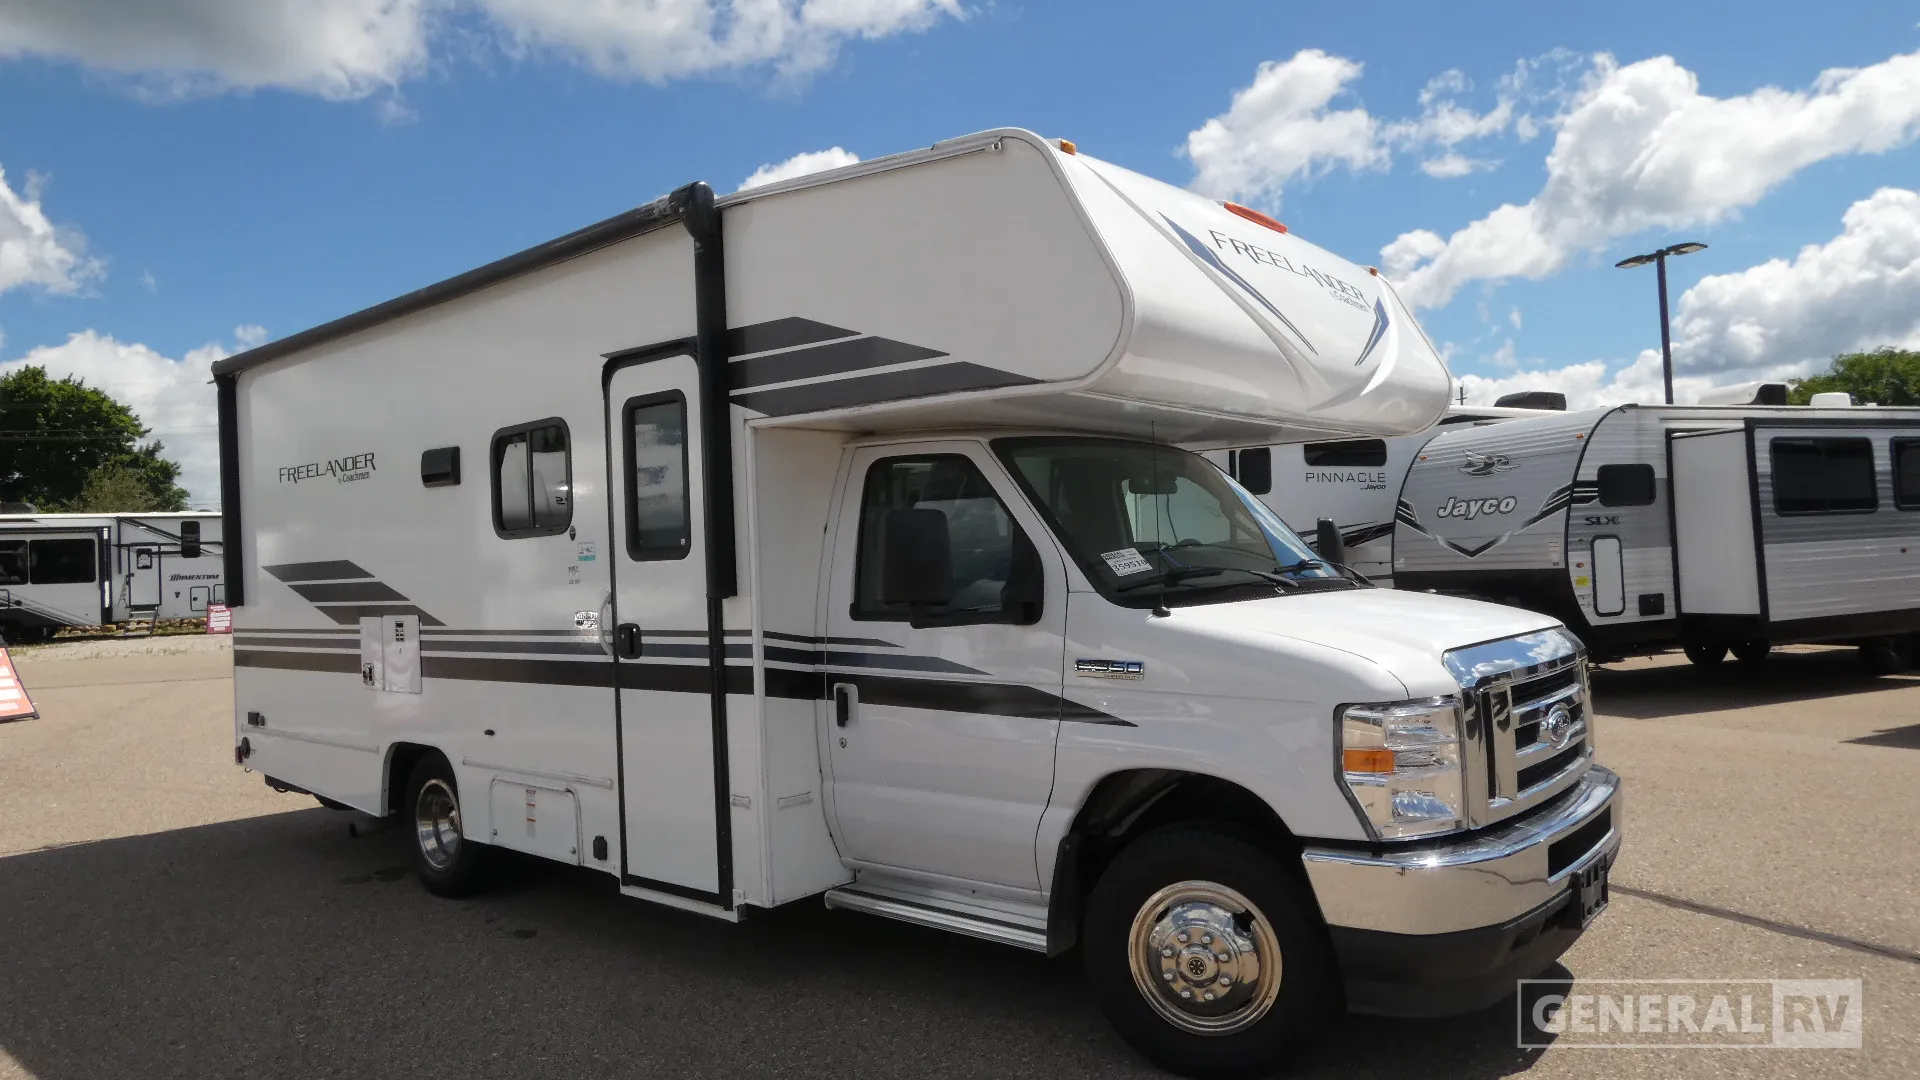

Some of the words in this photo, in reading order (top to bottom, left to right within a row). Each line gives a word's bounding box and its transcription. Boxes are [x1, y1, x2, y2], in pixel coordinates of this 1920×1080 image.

[1208, 229, 1371, 308] FREELANDER
[279, 453, 376, 483] FREELANDER
[1305, 472, 1386, 483] PINNACLE
[1437, 496, 1517, 520] Jayco
[1111, 559, 1148, 571] 359510
